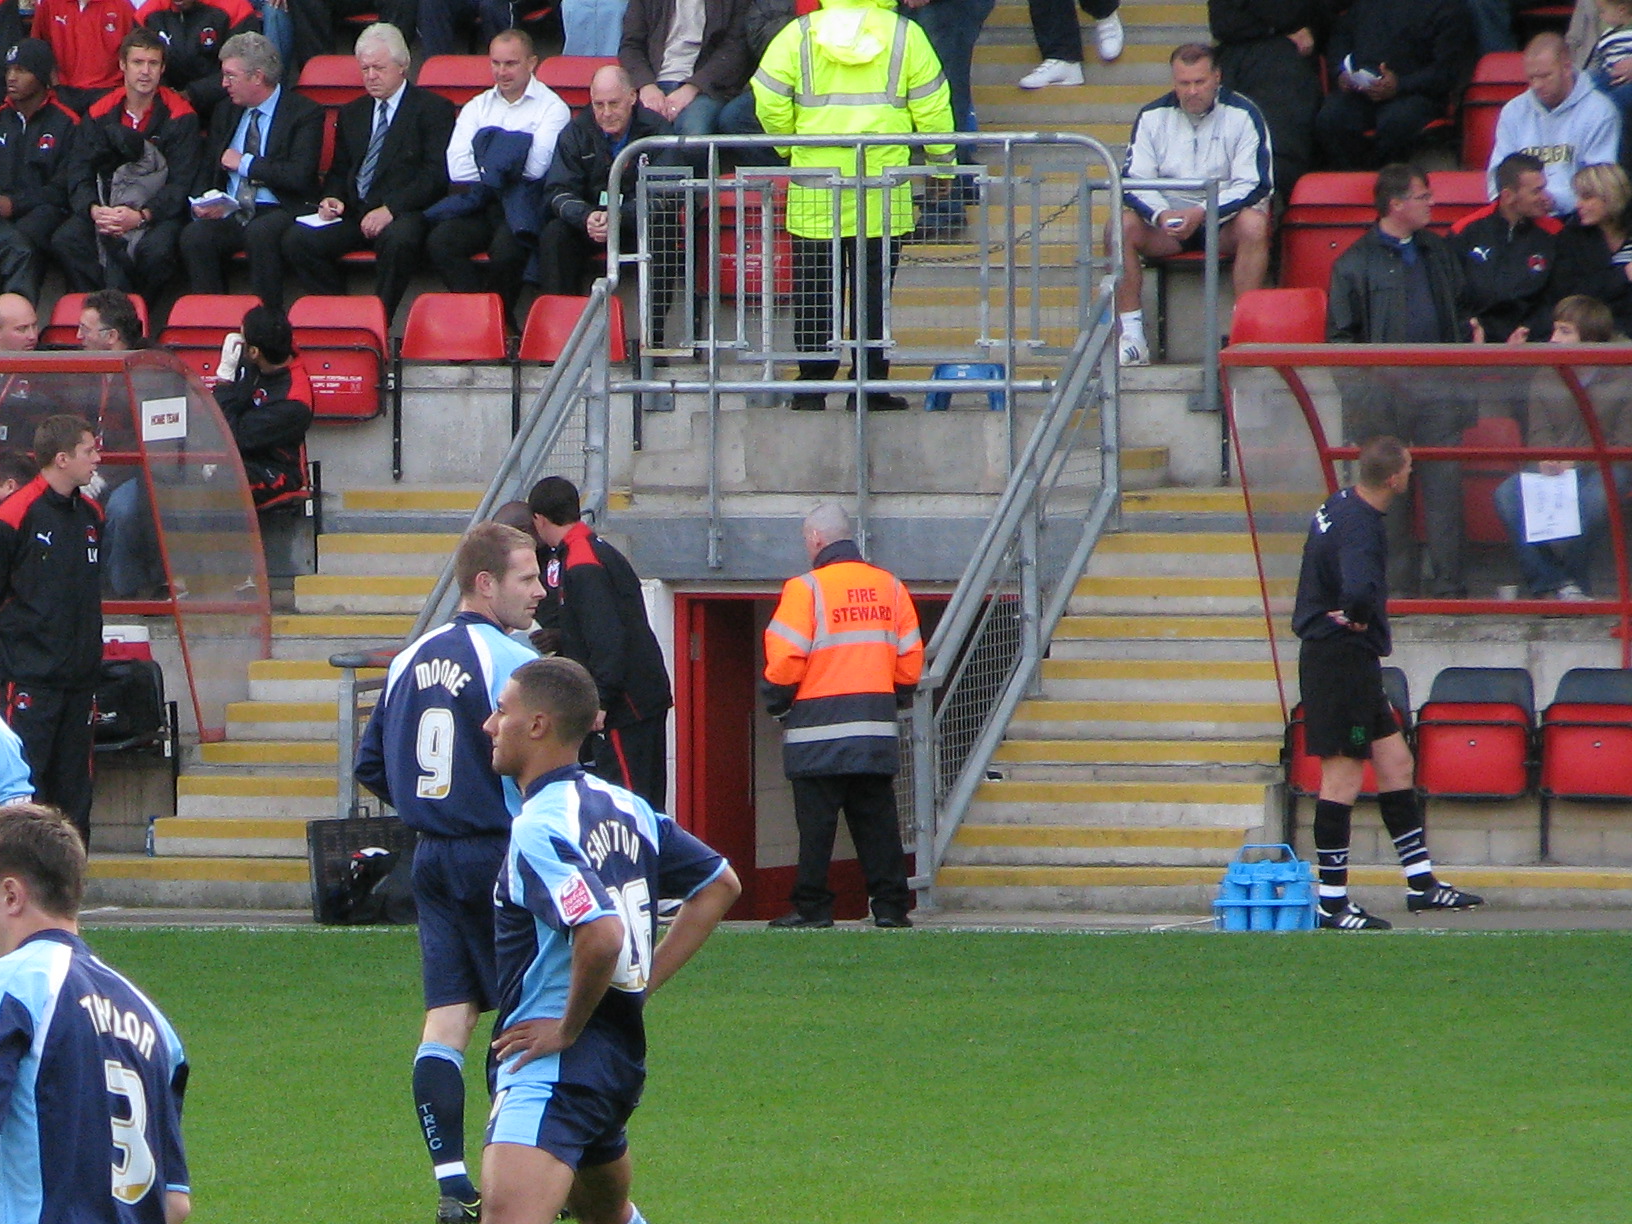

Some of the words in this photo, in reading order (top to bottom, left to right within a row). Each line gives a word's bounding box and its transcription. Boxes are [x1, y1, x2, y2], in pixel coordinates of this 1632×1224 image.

[166, 412, 180, 424] TEAM
[832, 606, 892, 623] STEWARD
[847, 588, 878, 603] FIRE
[415, 658, 472, 697] MOORE
[416, 707, 455, 799] 9
[104, 1059, 156, 1205] 3
[418, 1102, 443, 1150] TRFC
